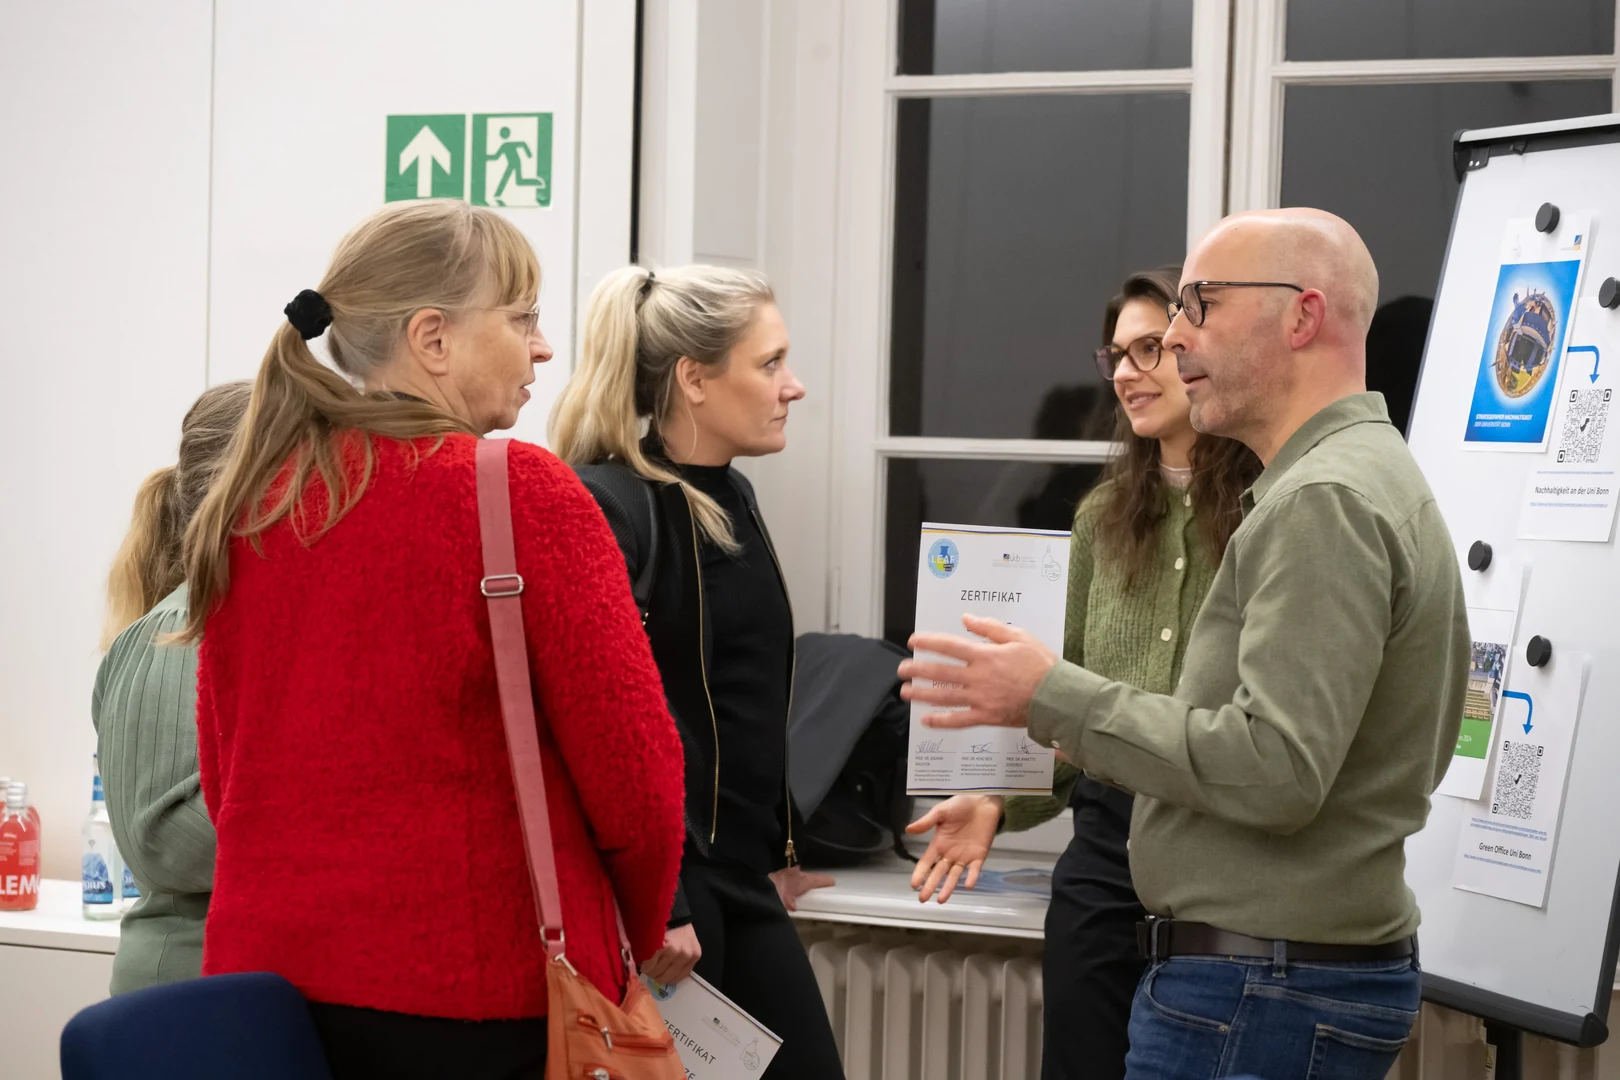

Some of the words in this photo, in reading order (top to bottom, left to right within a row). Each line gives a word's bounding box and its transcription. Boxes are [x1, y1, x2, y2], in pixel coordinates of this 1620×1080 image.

[1534, 486, 1569, 496] Nachhaltigkeit
[1577, 486, 1586, 494] der
[1586, 487, 1596, 495] Uni
[1596, 487, 1609, 495] Bonn
[960, 589, 1022, 603] ZERTIFIKAT
[1478, 842, 1494, 853] Green
[1494, 845, 1509, 856] Office
[1509, 848, 1519, 858] Uni
[1519, 850, 1532, 860] Bonn
[0, 874, 40, 896] LEM
